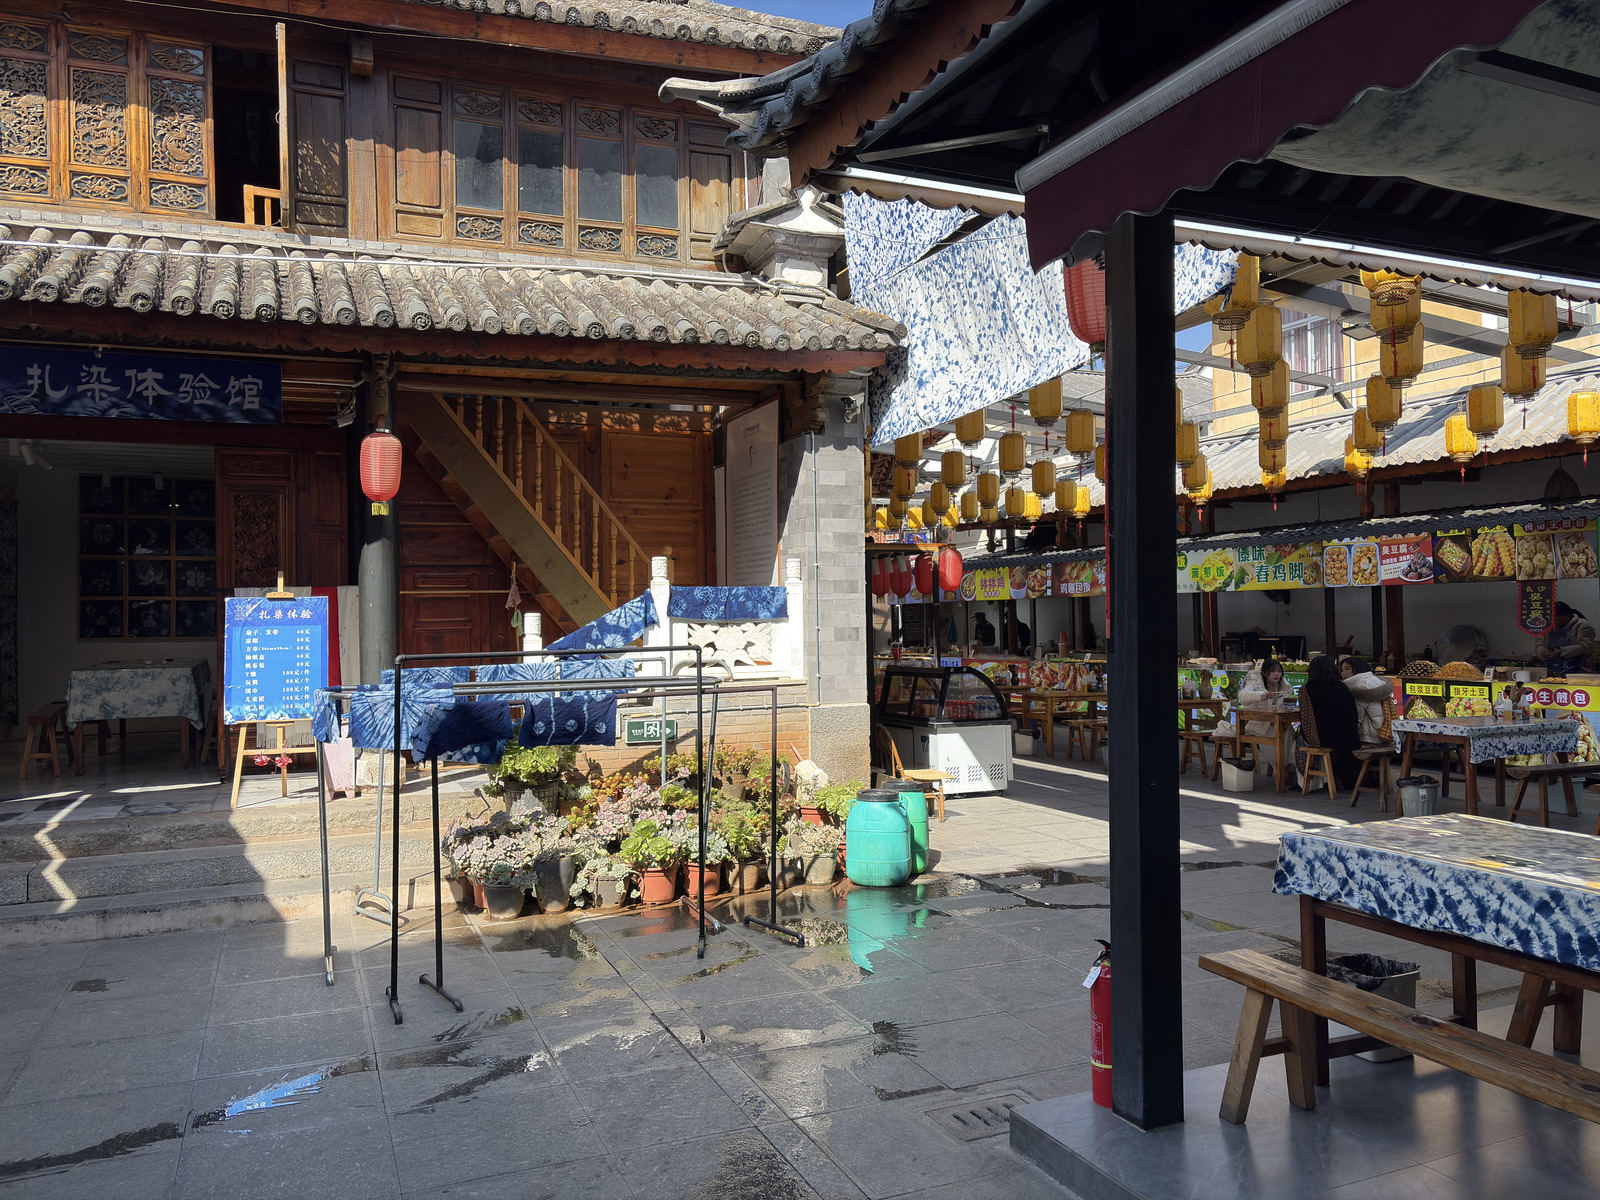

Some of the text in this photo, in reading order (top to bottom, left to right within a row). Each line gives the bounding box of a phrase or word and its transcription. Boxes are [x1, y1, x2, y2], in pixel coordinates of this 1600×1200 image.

[26, 362, 263, 410] 扎染体验馆
[1381, 543, 1408, 556] 臭豆腐
[1191, 565, 1225, 579] 菠萝饭
[980, 576, 1005, 590] 钵钵鸡
[259, 609, 313, 619] 扎染体验
[1409, 685, 1439, 695] 包浆豆腐
[1453, 687, 1486, 697] 狼牙土豆
